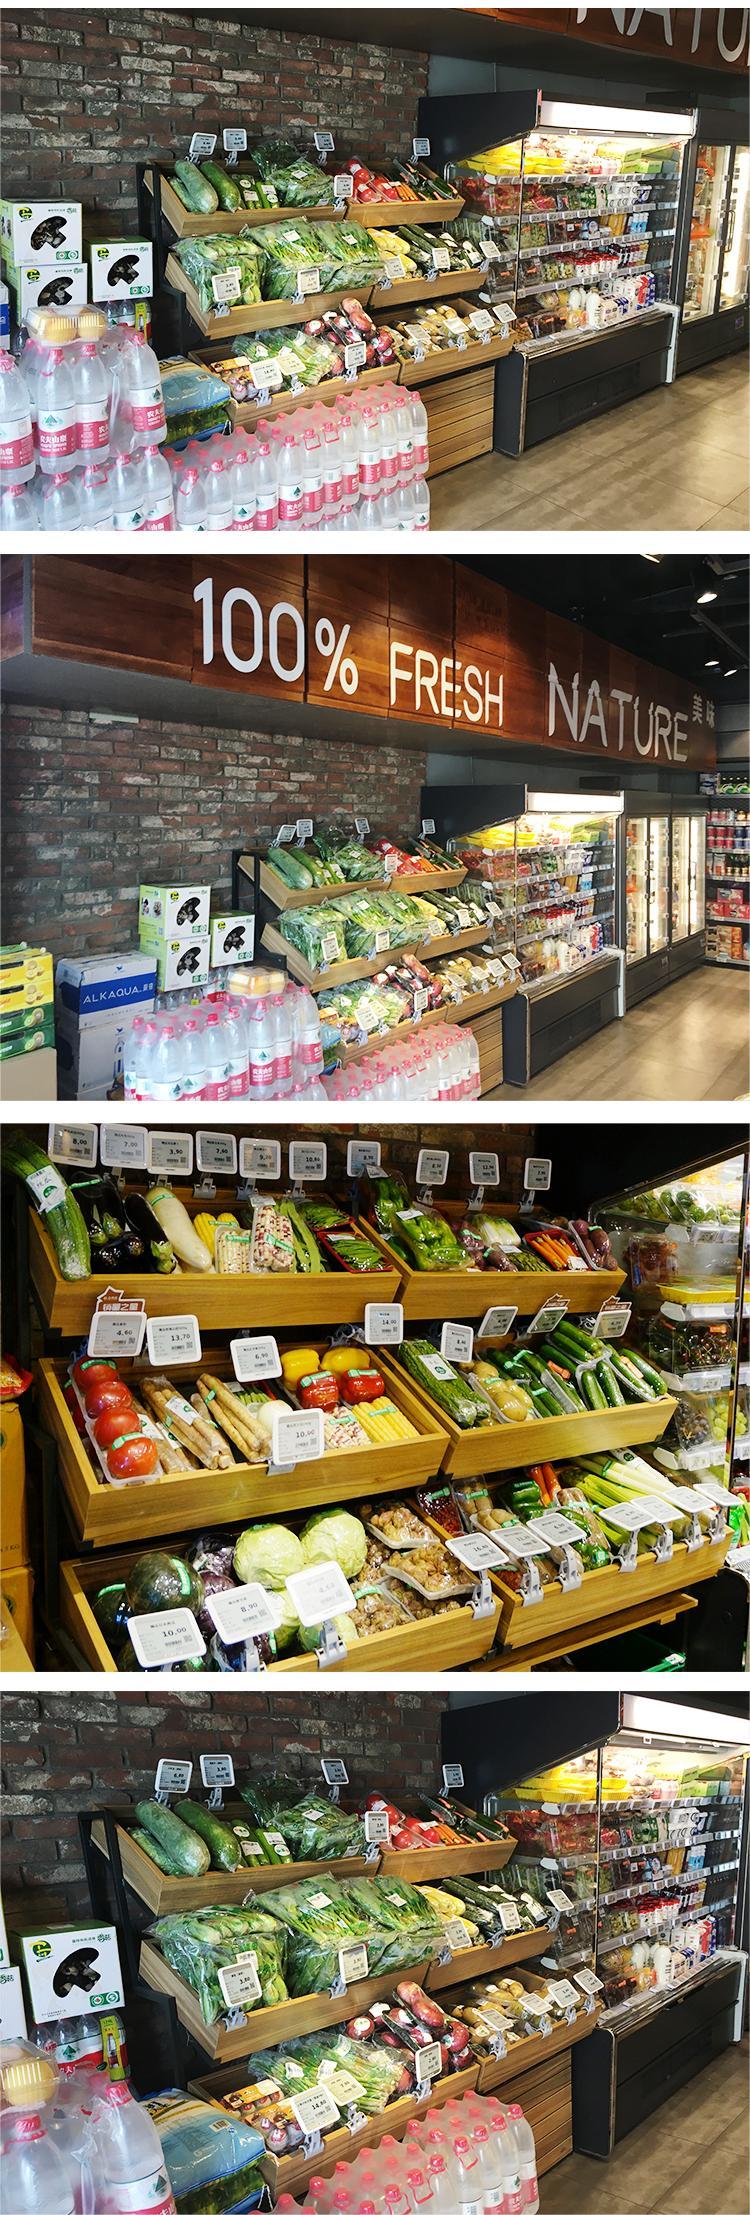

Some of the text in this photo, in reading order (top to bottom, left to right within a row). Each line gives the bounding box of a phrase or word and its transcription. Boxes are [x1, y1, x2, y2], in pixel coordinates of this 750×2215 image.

[389, 641, 504, 727] FRESH
[548, 662, 688, 763] NATURE
[83, 985, 140, 1004] ALKAQUA
[255, 1352, 268, 1360] 6.90
[240, 1602, 259, 1613] 8.90
[162, 1627, 187, 1638] 10.00
[311, 2100, 327, 2110] 14.80
